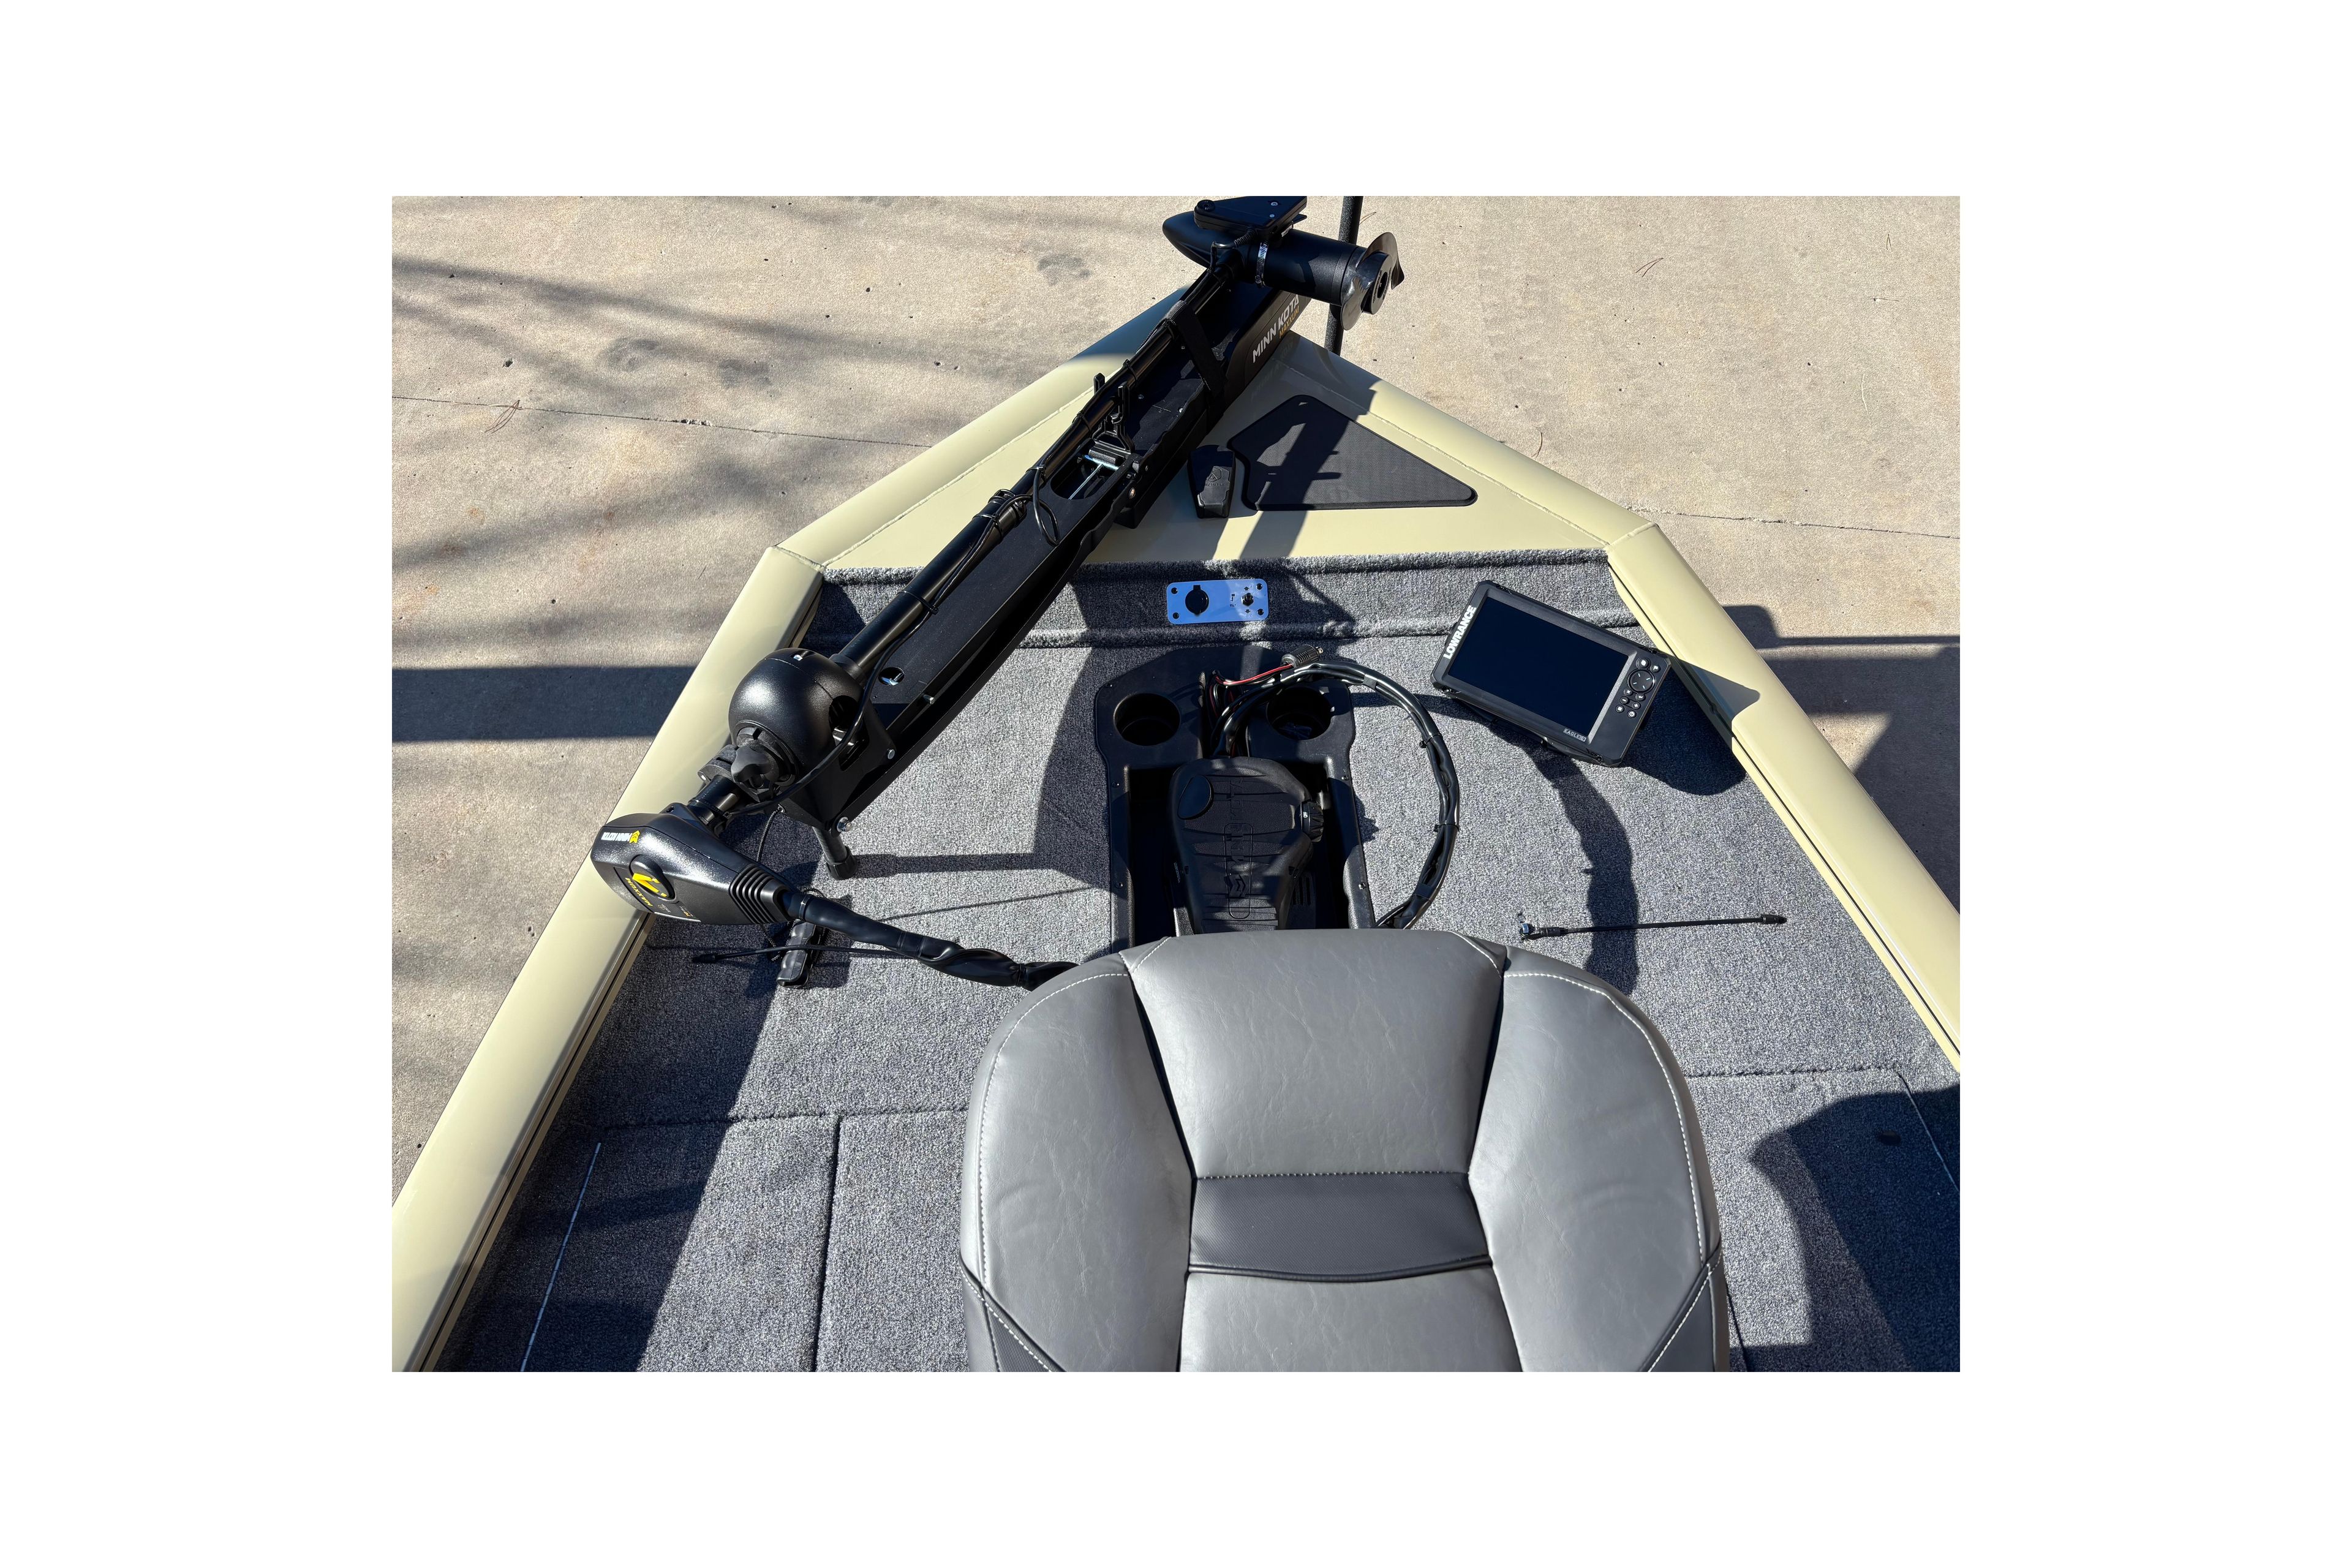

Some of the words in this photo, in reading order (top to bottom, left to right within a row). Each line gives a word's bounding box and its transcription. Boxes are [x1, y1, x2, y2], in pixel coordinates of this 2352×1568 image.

[1253, 322, 1276, 363] MINN
[1278, 294, 1299, 331] KOTA
[1279, 306, 1299, 339] MAXXUM
[1443, 605, 1477, 659] LOWRANCE
[1562, 728, 1580, 739] EAGLE
[625, 877, 653, 907] MAXXUM
